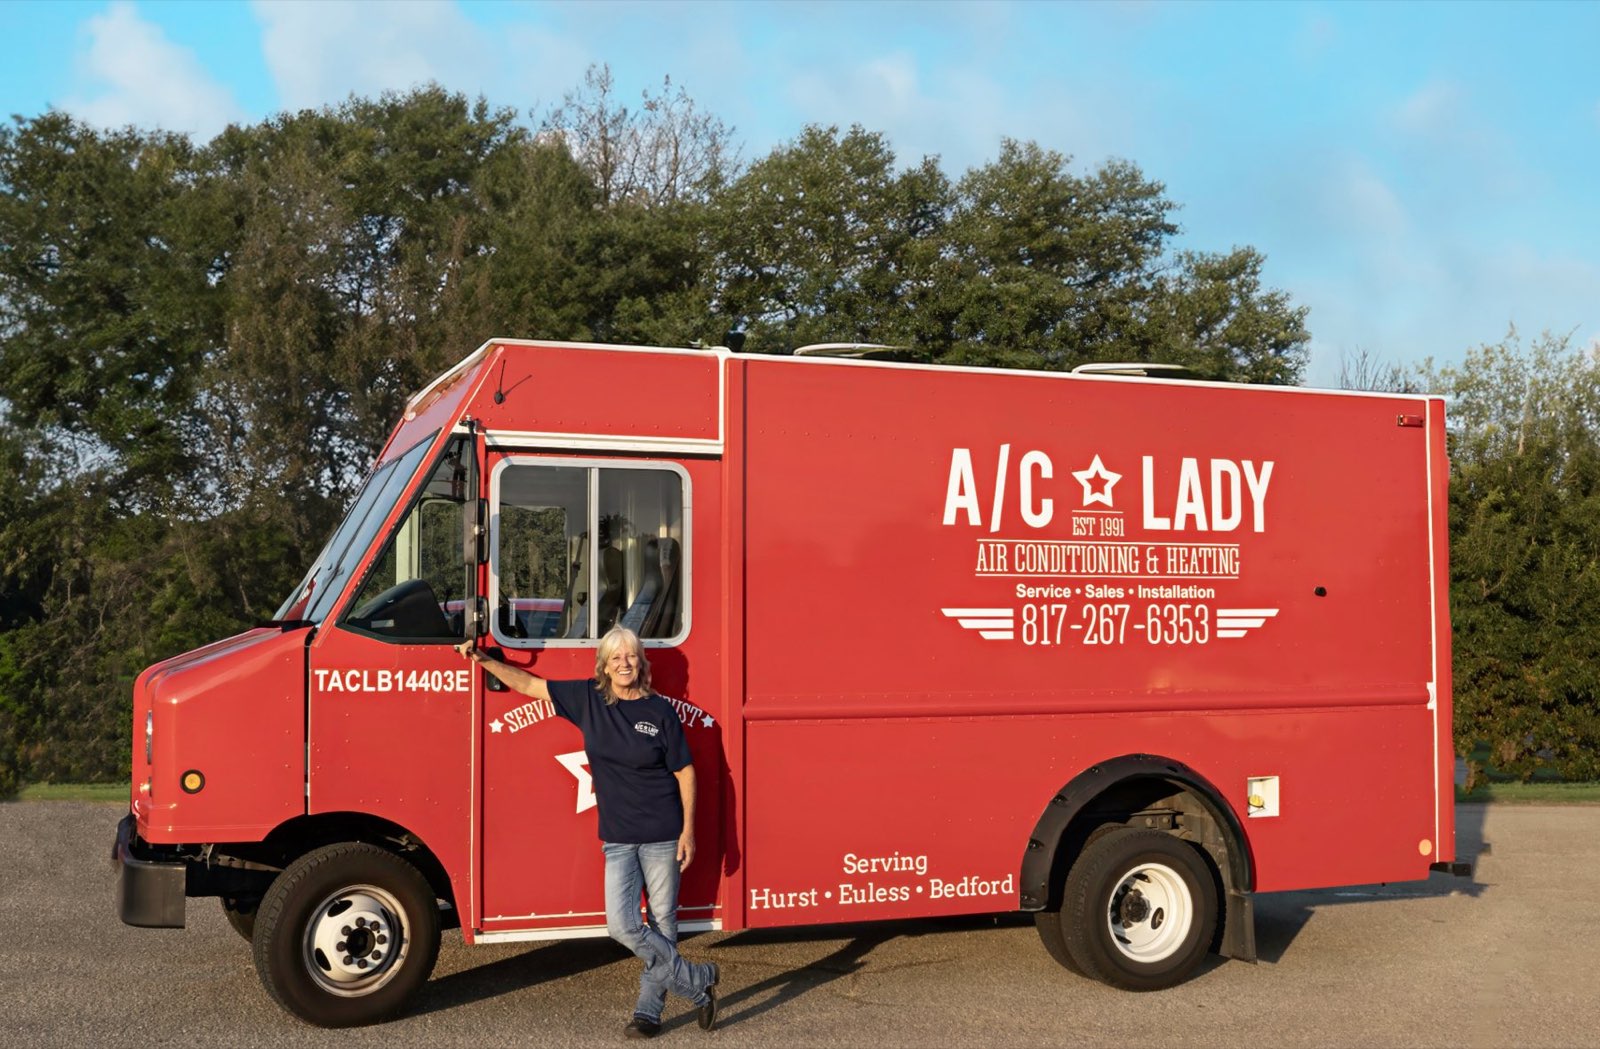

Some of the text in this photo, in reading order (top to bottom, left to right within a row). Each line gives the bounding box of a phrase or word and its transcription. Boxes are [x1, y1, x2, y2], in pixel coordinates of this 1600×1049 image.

[942, 443, 1275, 533] A/C LADY
[1072, 516, 1125, 537] EST 1991
[975, 543, 1240, 575] AIR CONDITIONING & HEATING
[1016, 583, 1215, 599] Service Sales Installation
[1022, 603, 1209, 646] 817-267-6353
[314, 669, 470, 693] TACLB14403E
[503, 699, 556, 733] SERVI
[843, 851, 928, 876] Serving
[750, 873, 1014, 910] Hurst Euless Bedford
